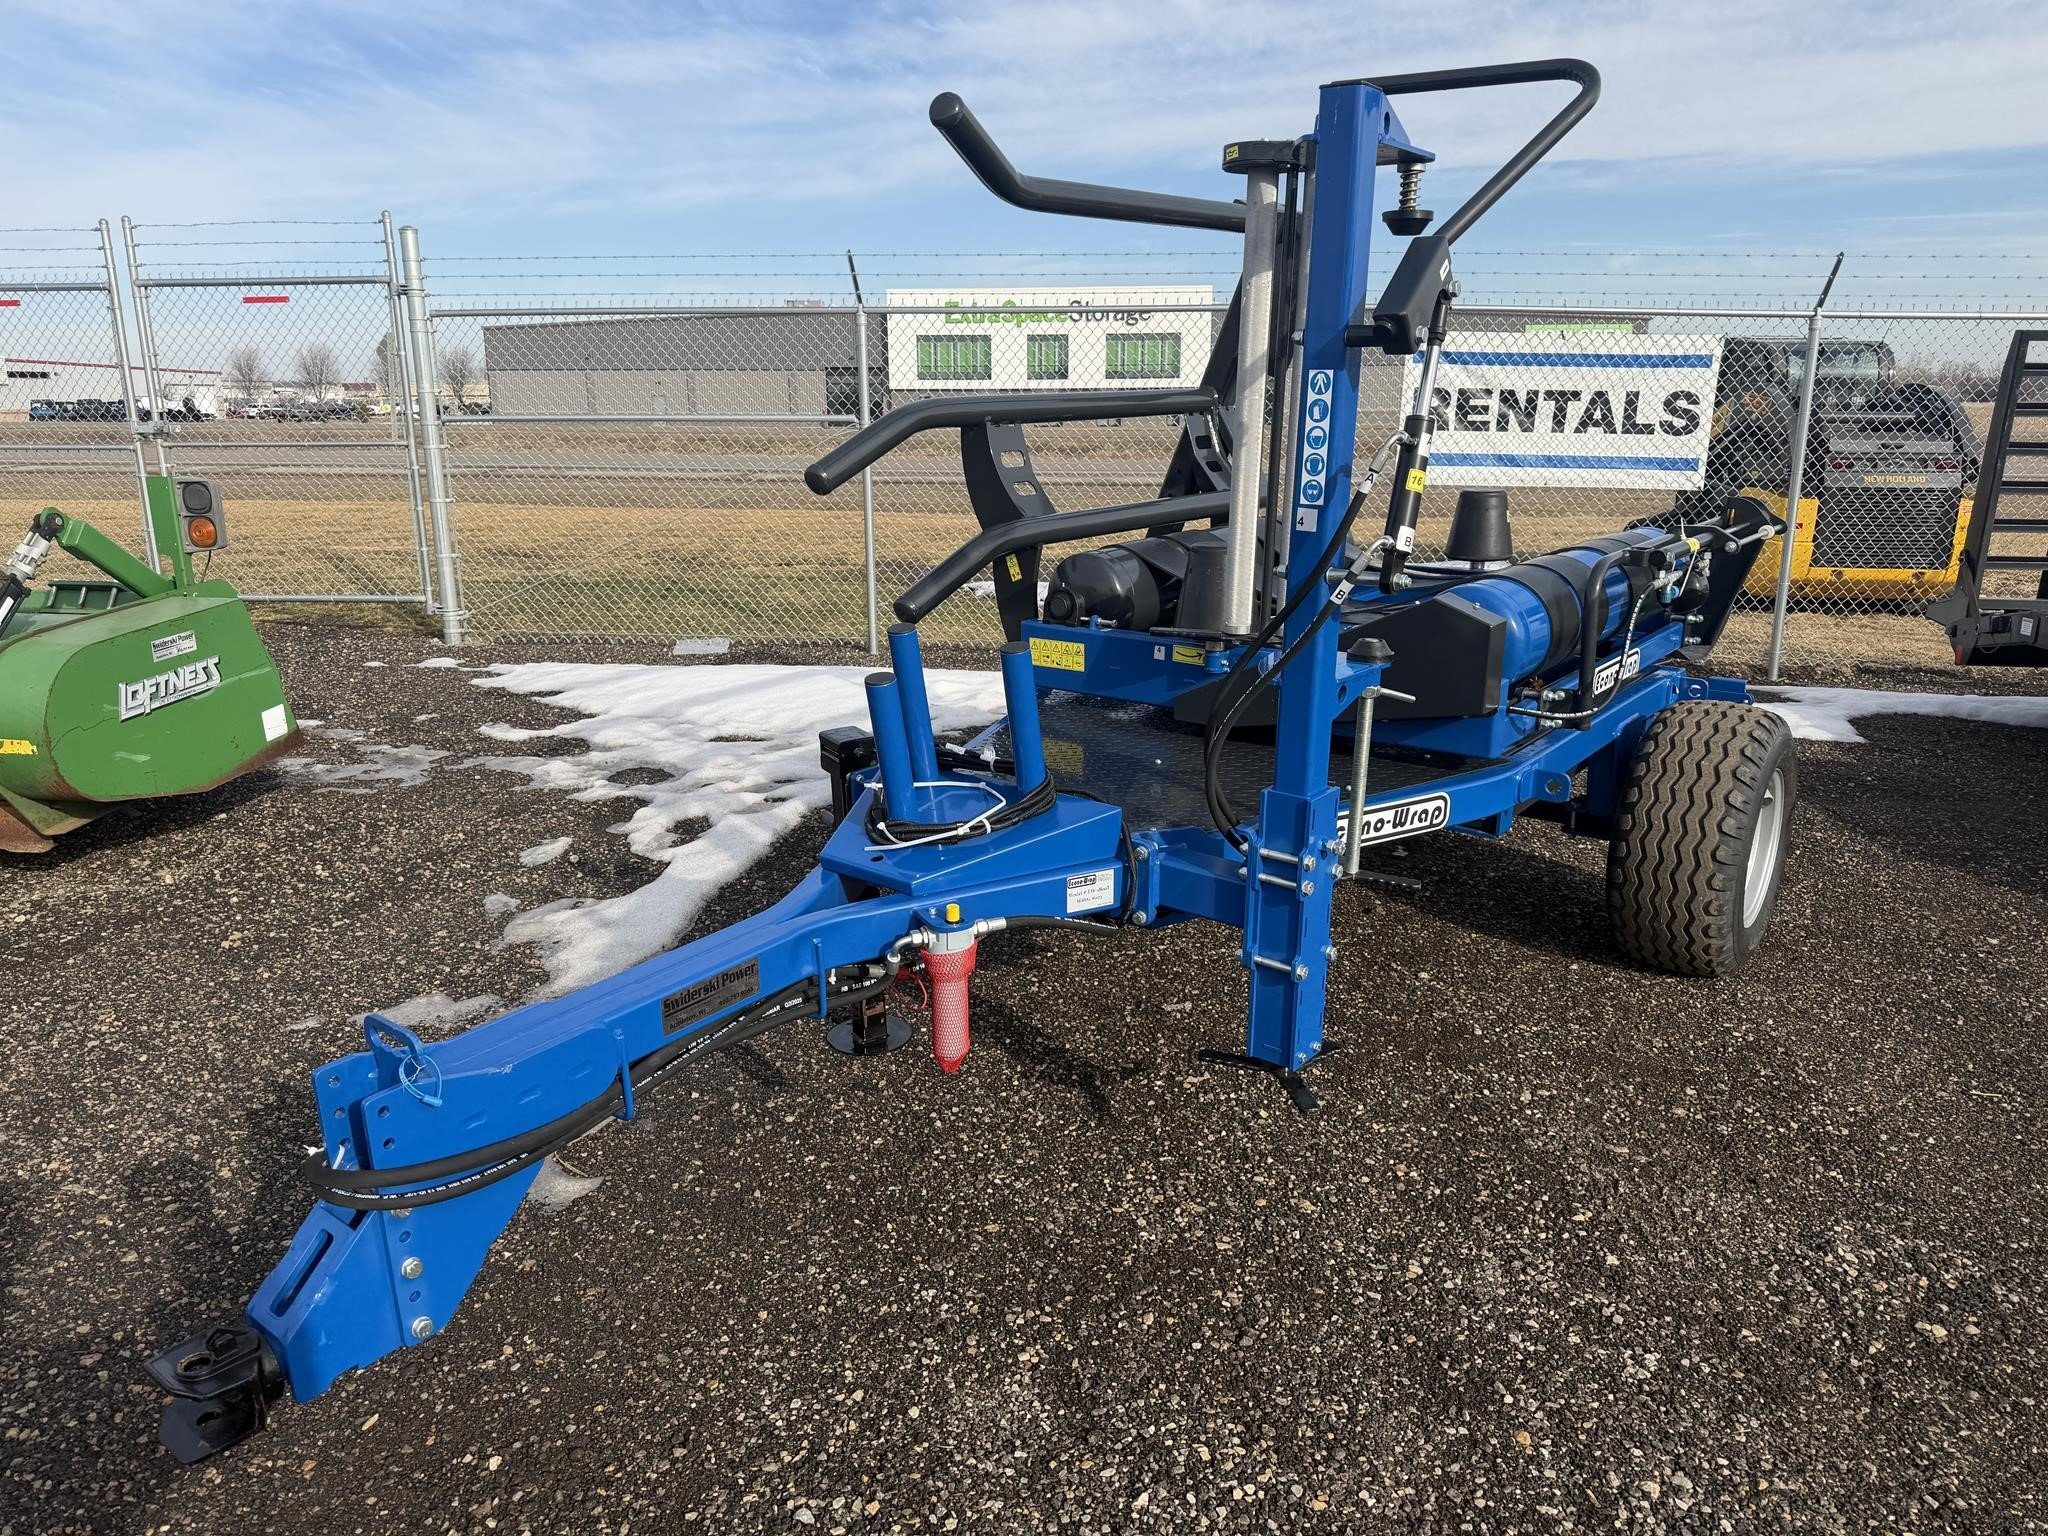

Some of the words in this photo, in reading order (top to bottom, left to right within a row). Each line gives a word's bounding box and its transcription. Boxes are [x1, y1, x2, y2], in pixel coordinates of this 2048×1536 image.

[1413, 387, 1701, 437] RENTALS
[1365, 473, 1374, 484] A
[1412, 475, 1423, 486] 16
[1864, 475, 1885, 483] NEW
[1886, 475, 1926, 484] HOLLAND
[1297, 516, 1305, 527] 4
[1404, 536, 1412, 547] B
[1335, 589, 1346, 600] B
[118, 655, 221, 721] LOFTNESS
[663, 976, 720, 1014] Swiderski
[721, 963, 756, 987] Power
